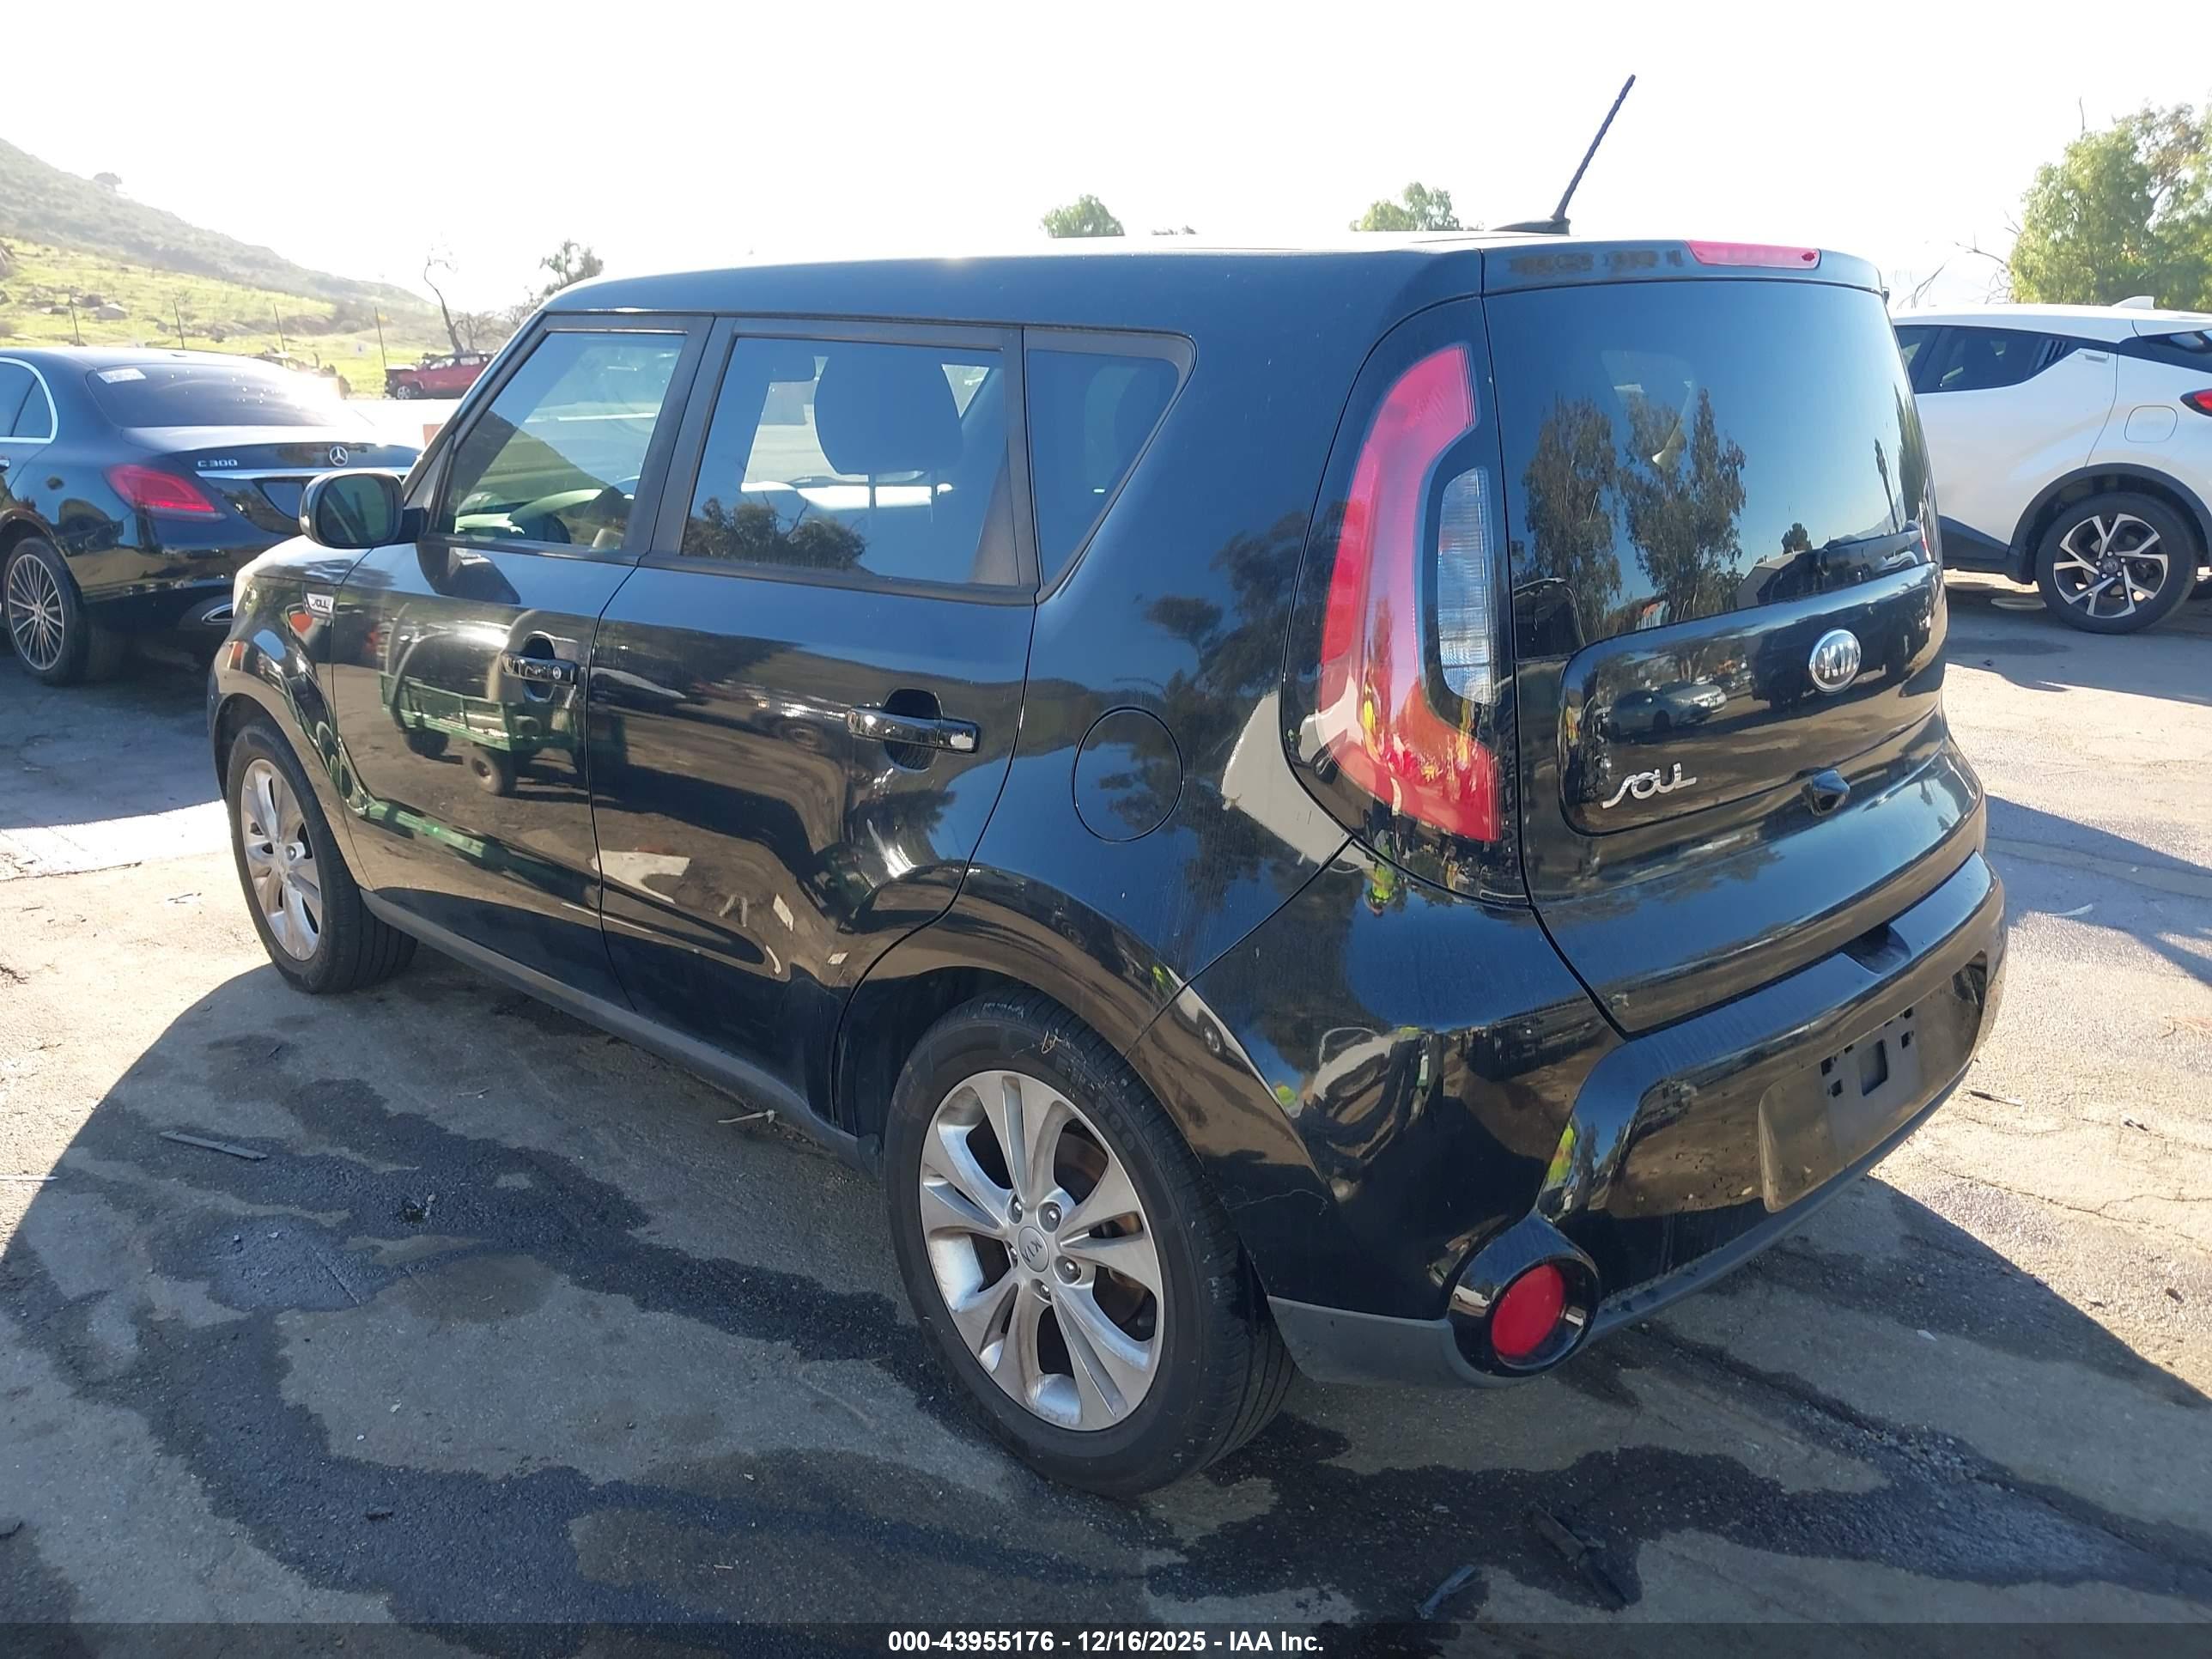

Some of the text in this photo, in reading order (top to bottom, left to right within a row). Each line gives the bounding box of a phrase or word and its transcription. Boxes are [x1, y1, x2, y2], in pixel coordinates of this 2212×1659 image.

[198, 459, 238, 468] C 300
[1820, 641, 1858, 679] KIA
